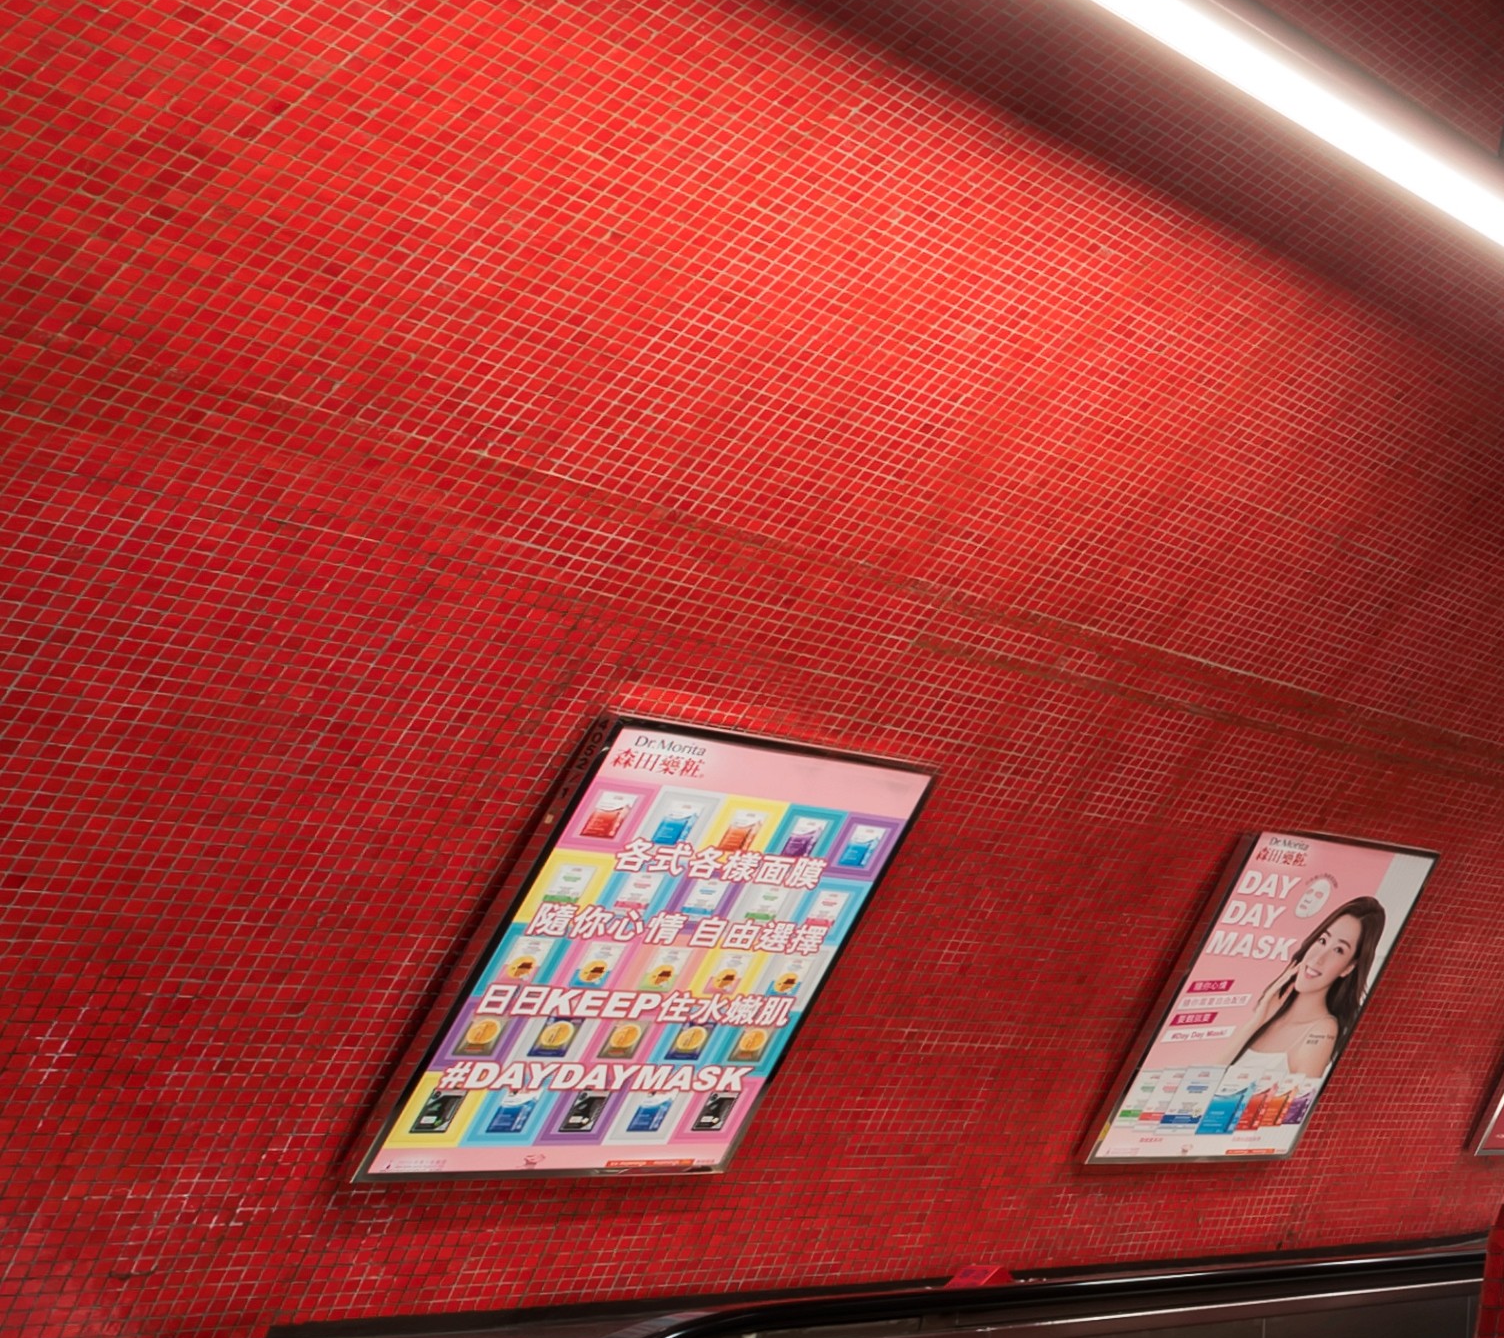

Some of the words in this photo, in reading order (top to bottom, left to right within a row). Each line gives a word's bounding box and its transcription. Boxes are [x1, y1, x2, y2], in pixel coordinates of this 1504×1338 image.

[615, 836, 828, 890] 各式各樣面膜
[1237, 869, 1302, 899] DAY
[525, 902, 688, 947] 隨你心情
[688, 916, 830, 957] 自由選擇
[1221, 900, 1287, 929] DAY
[1205, 930, 1297, 962] MASK
[475, 983, 797, 1028] 日日KEEP住水嫩肌
[438, 1061, 755, 1093] #DAYDAYMASK
